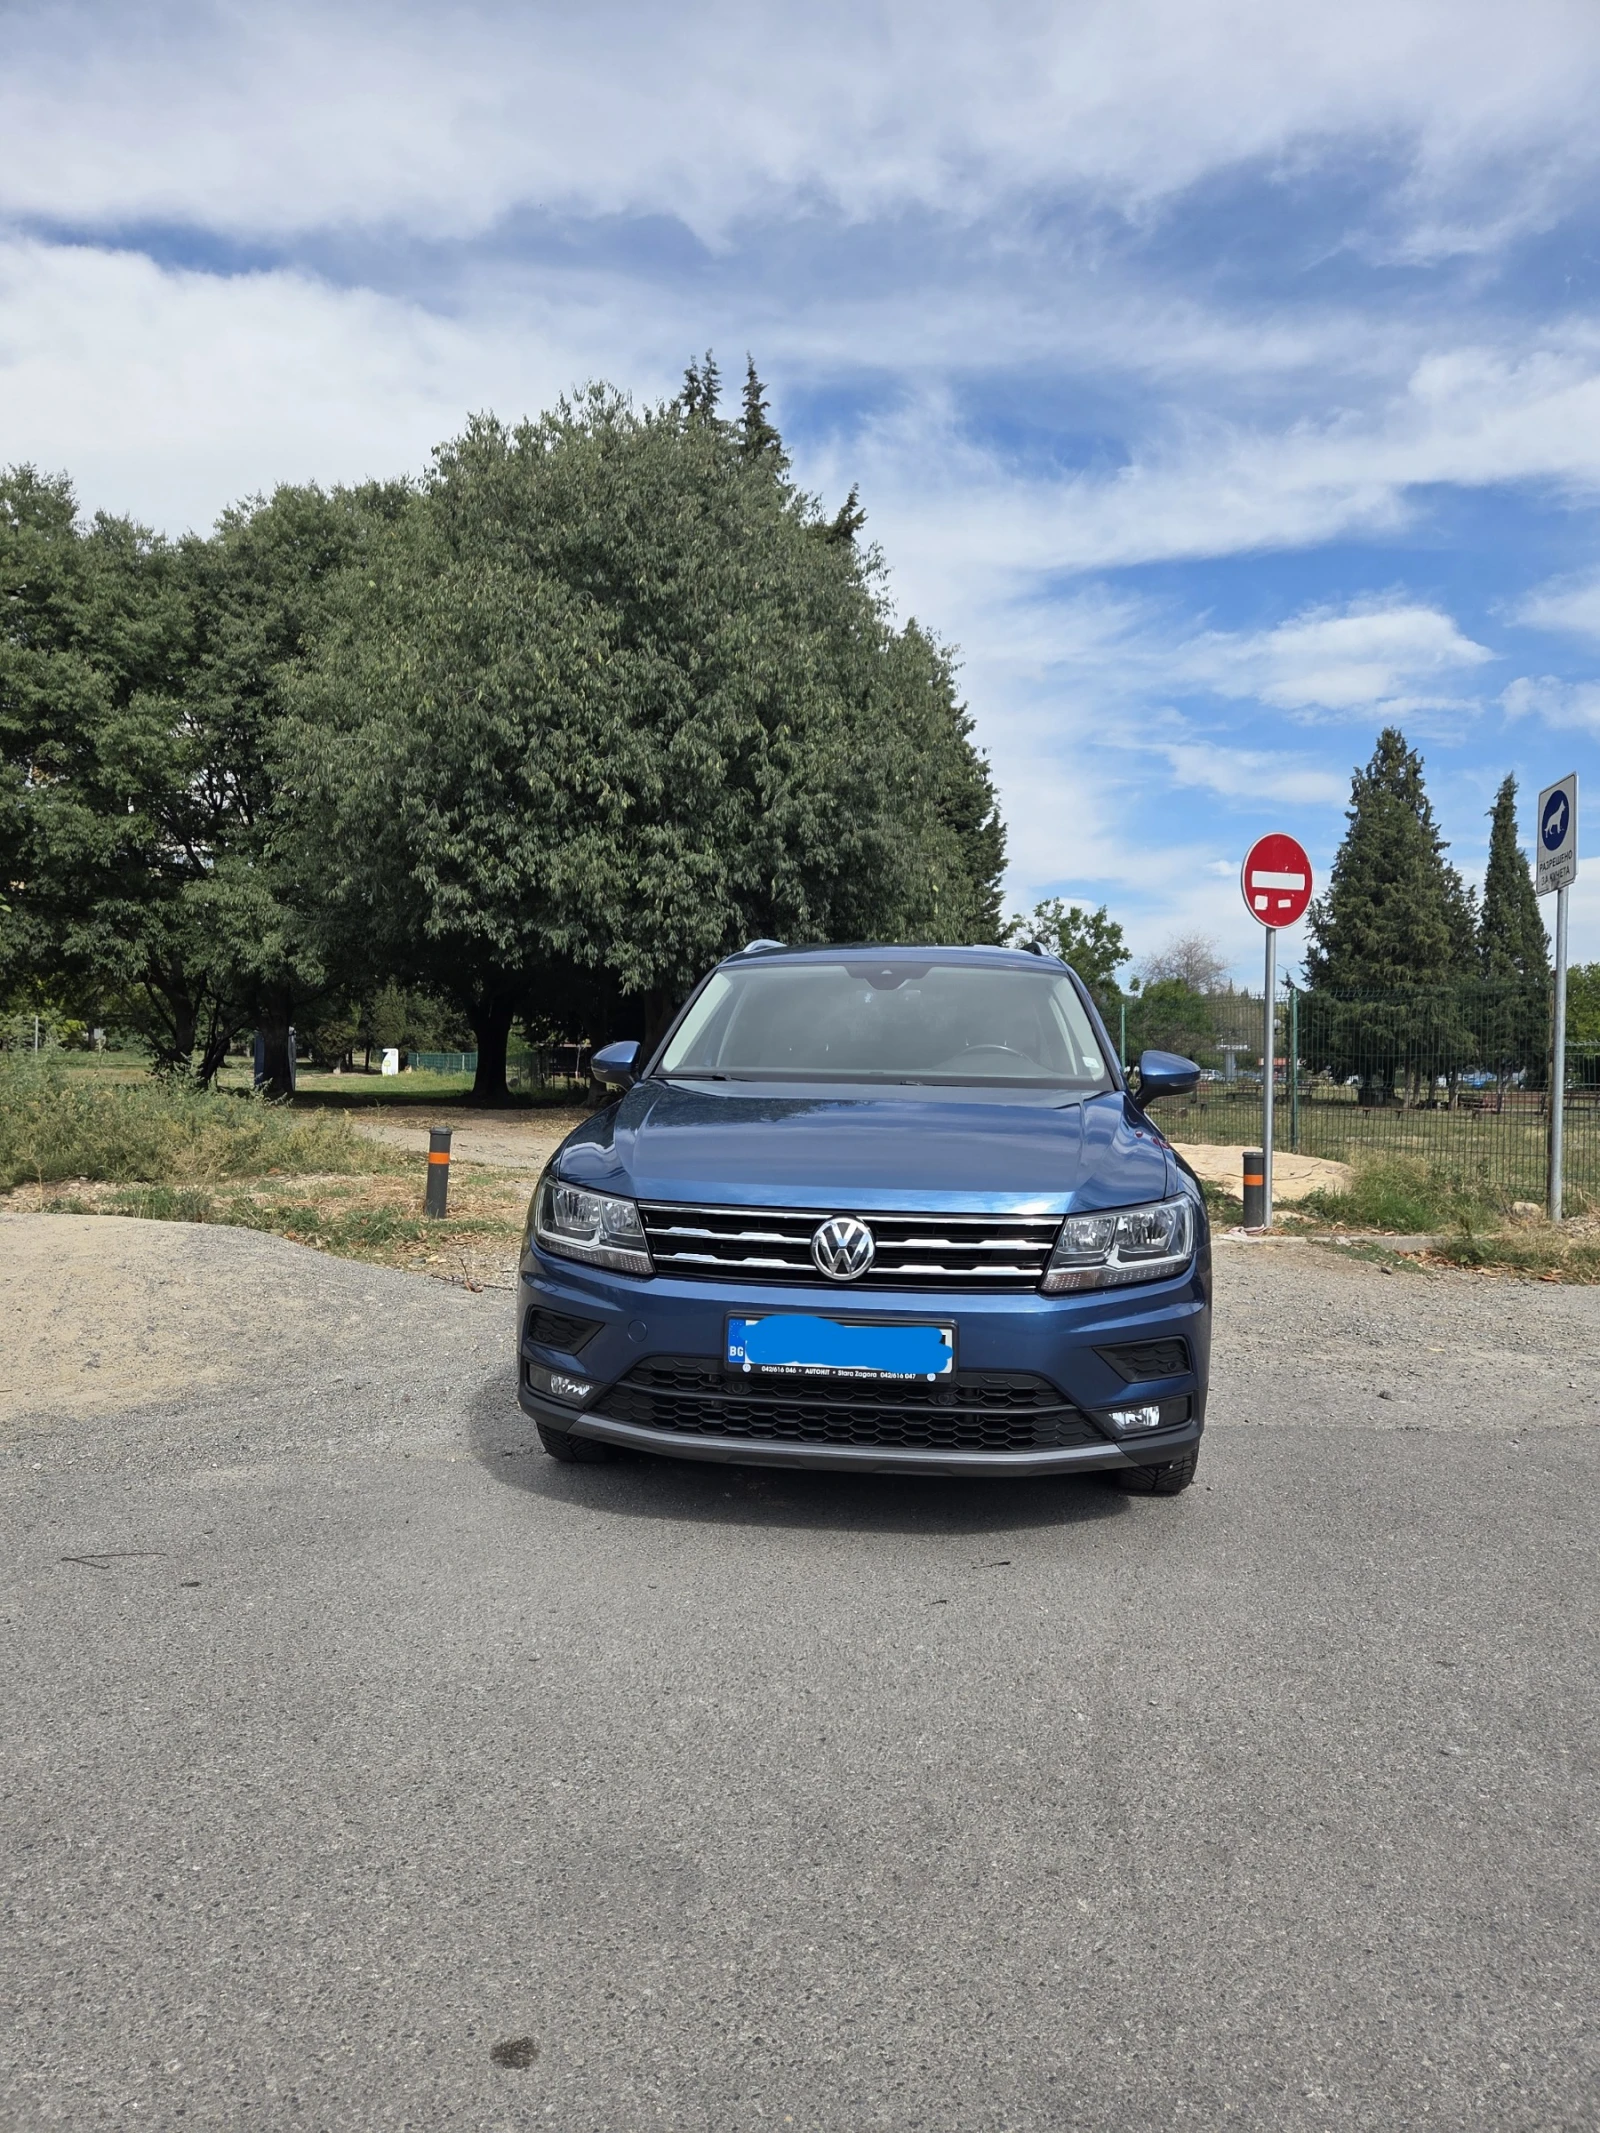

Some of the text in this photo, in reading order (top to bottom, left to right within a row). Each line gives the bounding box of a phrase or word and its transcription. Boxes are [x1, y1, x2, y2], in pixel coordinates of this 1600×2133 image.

[1539, 849, 1573, 873] РАЗРЕШЕНО
[729, 1346, 744, 1357] BG
[761, 1365, 785, 1373] 042/616
[785, 1366, 797, 1374] 046
[854, 1370, 877, 1379] Zagora
